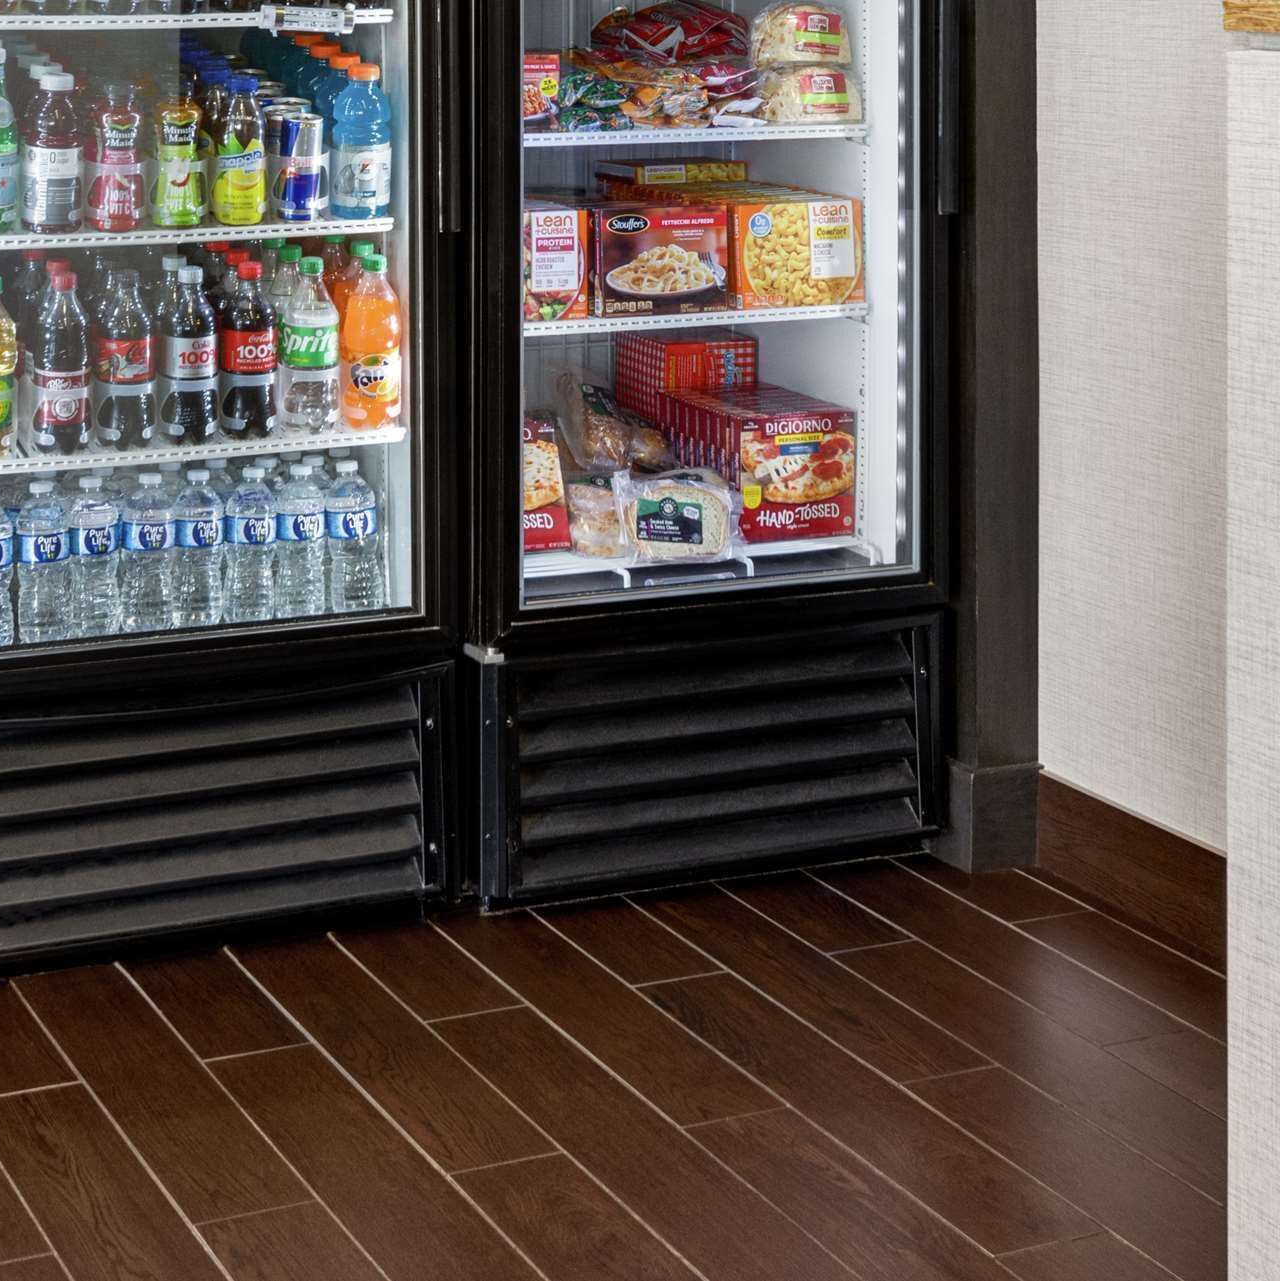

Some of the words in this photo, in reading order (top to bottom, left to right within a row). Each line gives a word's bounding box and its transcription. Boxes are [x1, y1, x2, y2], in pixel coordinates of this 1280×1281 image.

[813, 205, 848, 216] Lean
[537, 216, 573, 227] Lean
[611, 218, 645, 230] Stouffer's
[284, 326, 338, 354] Sprite
[298, 515, 316, 525] Pure
[347, 512, 365, 521] Pure
[756, 503, 840, 528] HAND-TOSSED
[197, 521, 215, 531] Pure
[248, 519, 267, 528] Pure
[300, 522, 316, 531] Life
[349, 520, 364, 529] Life
[89, 529, 108, 538] Pure
[144, 525, 164, 534] Pure
[200, 528, 216, 538] Life
[251, 527, 268, 536] Life
[38, 536, 57, 545] Pure
[91, 537, 107, 545] Life
[146, 533, 162, 542] Life
[40, 544, 56, 554] Life
